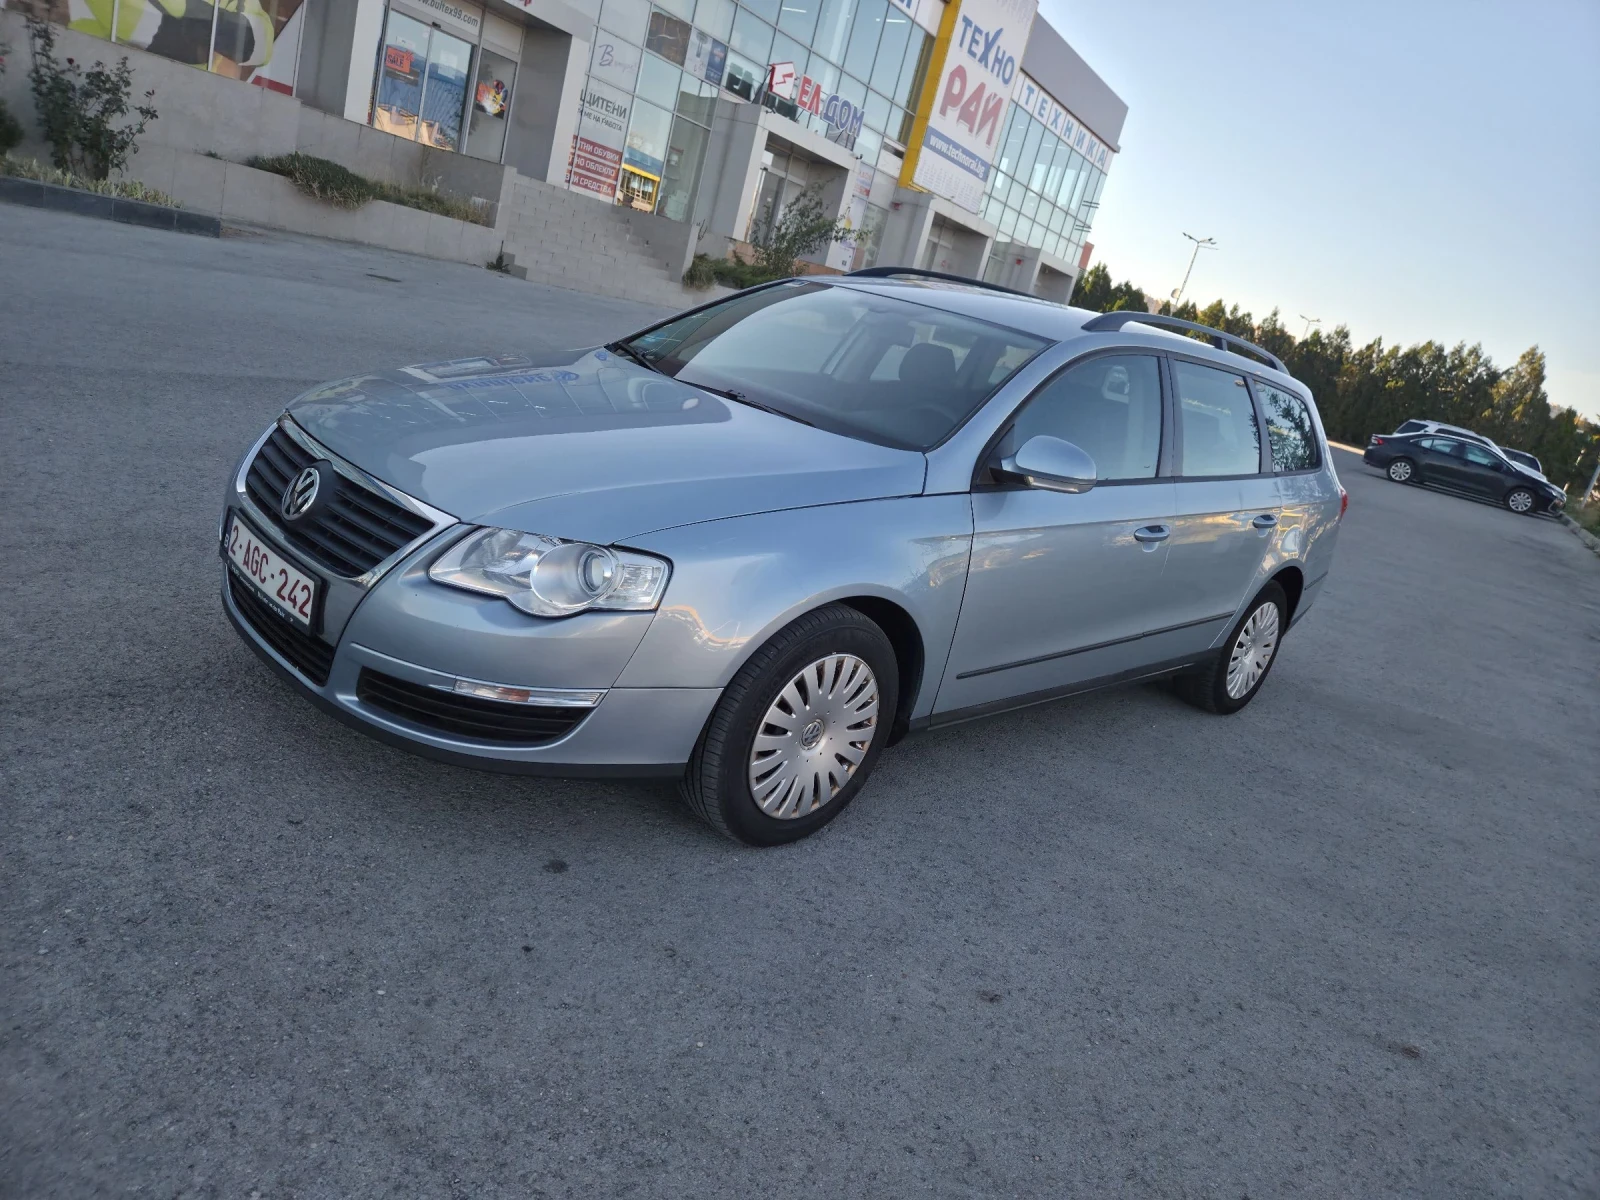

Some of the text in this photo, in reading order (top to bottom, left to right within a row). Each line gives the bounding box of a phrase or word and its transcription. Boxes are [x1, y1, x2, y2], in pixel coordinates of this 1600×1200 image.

[959, 14, 1015, 86] ТЕХНО
[938, 64, 1004, 147] РАЙ
[1025, 84, 1106, 167] ТЕХНИКА
